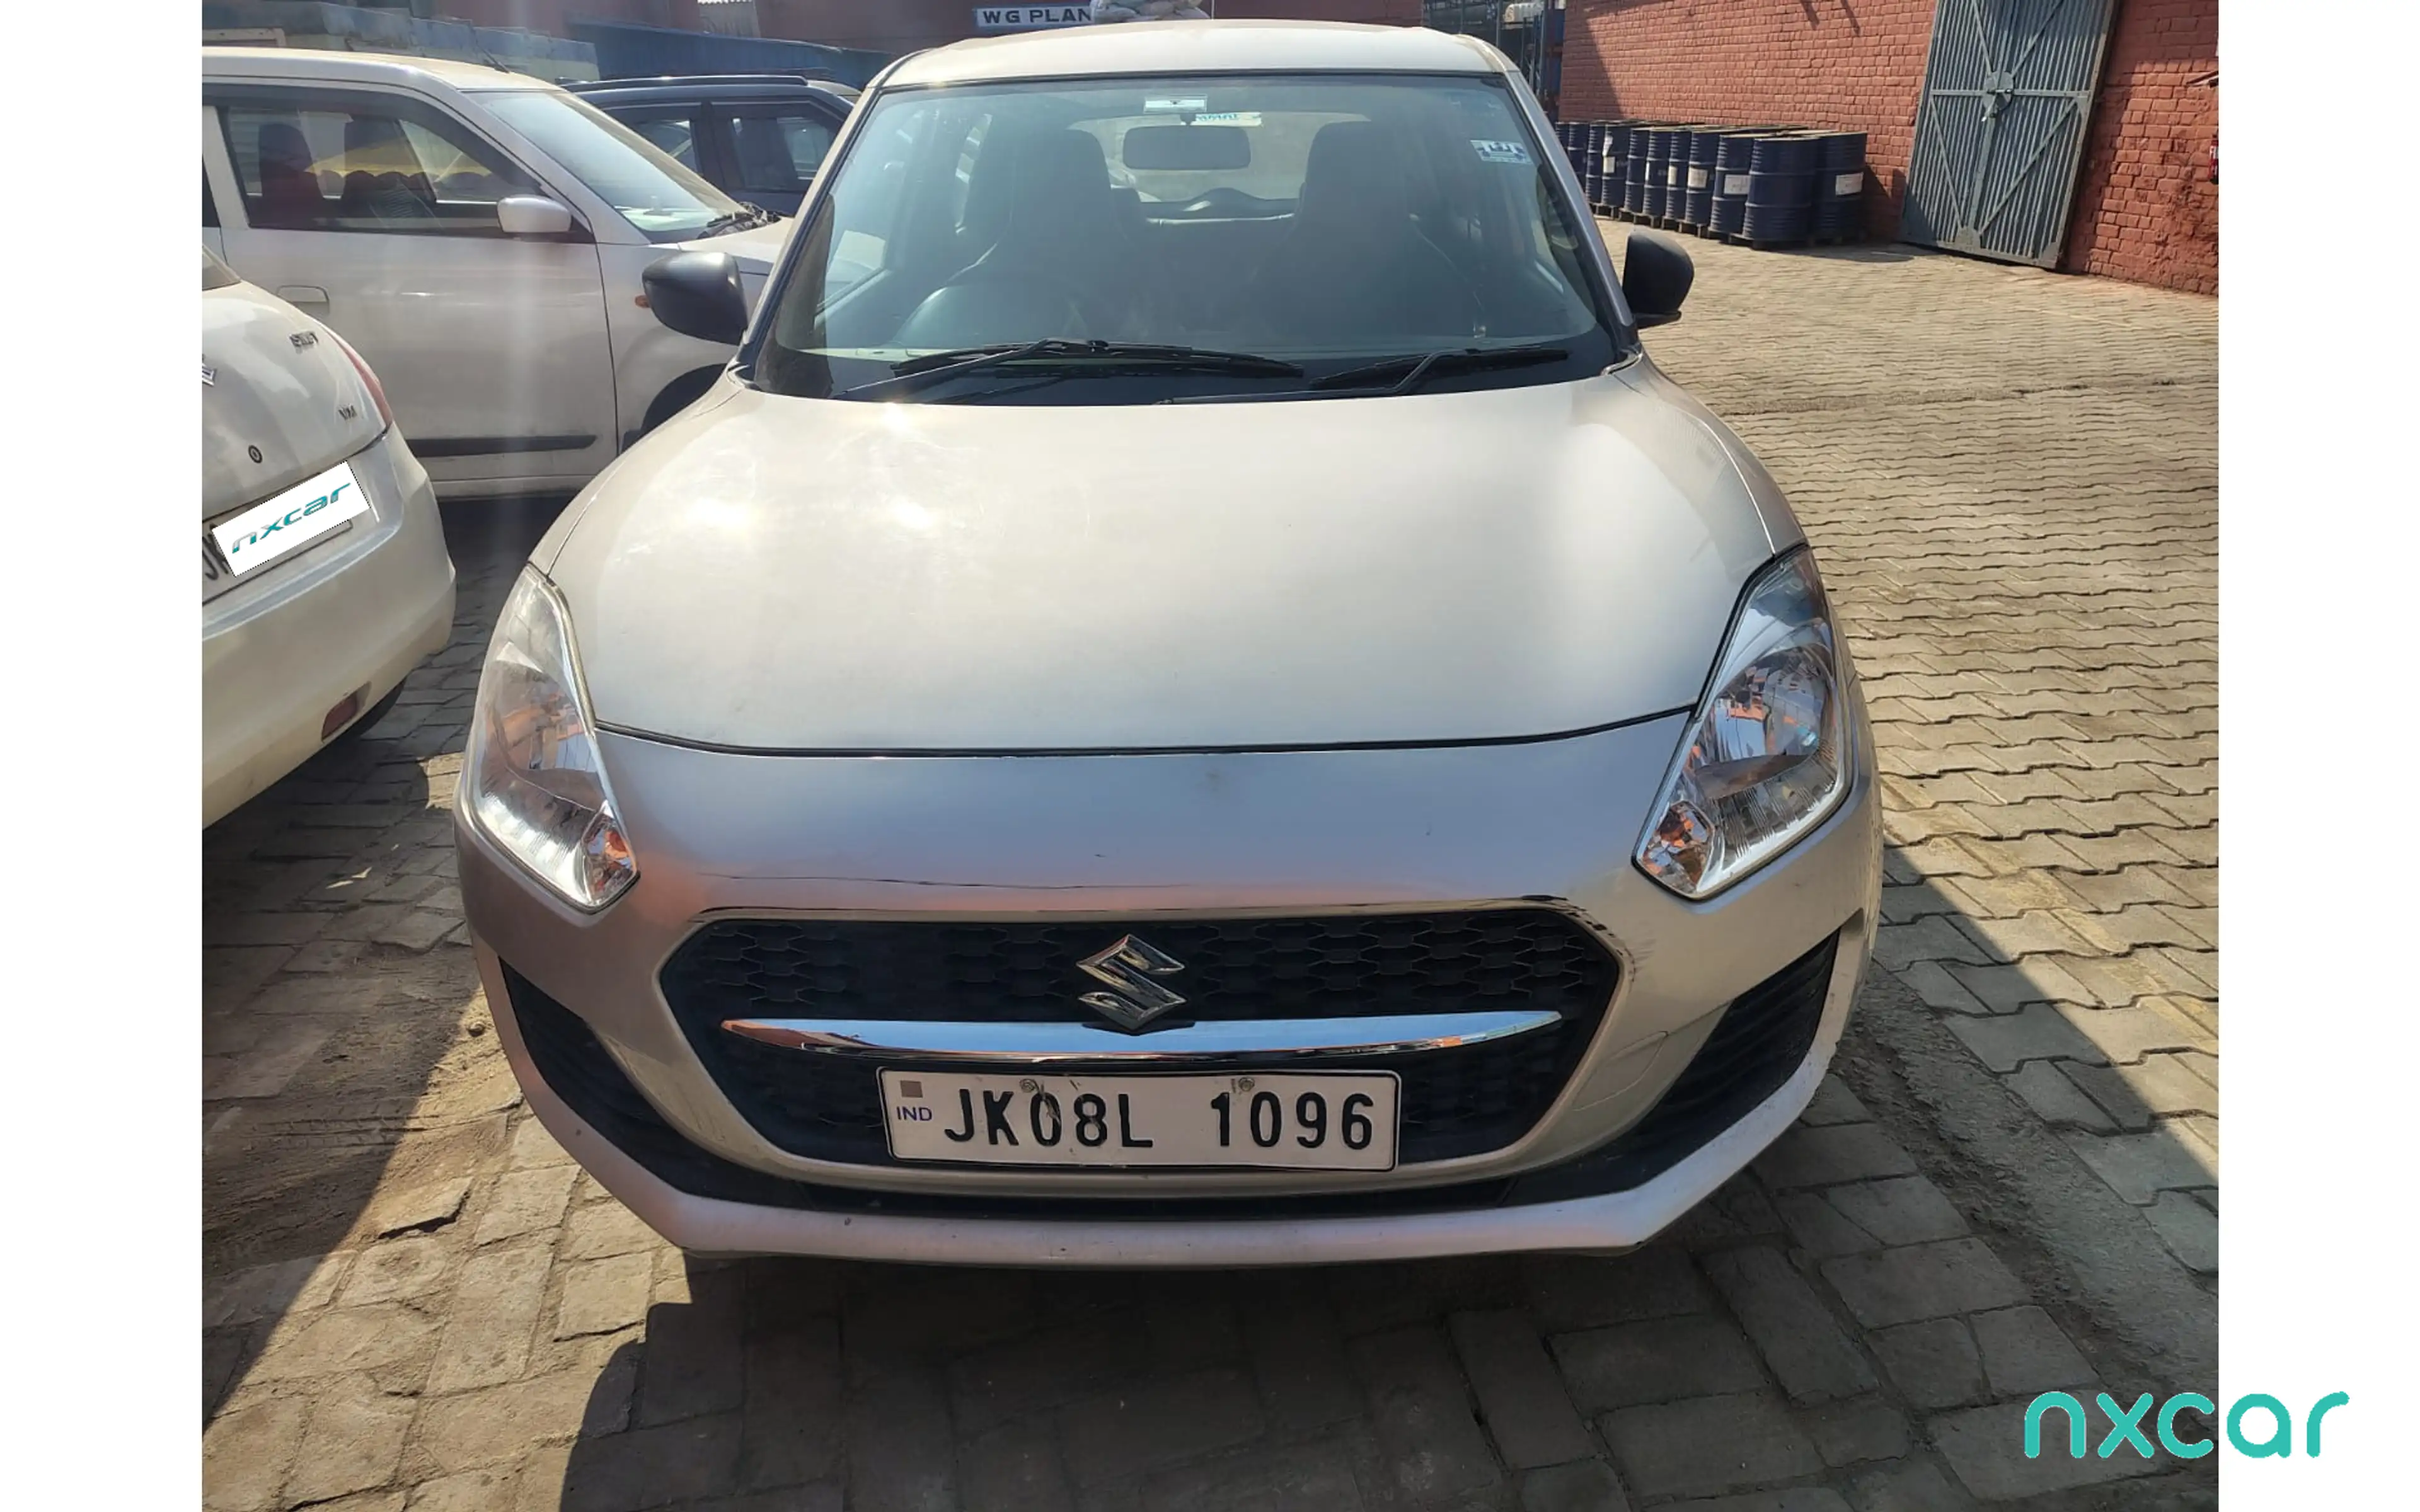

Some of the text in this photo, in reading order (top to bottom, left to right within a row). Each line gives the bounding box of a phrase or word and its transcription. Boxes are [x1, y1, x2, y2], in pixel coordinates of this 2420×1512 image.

[982, 10, 1021, 23] WG
[896, 1106, 933, 1121] IND
[944, 1089, 1374, 1150] JK08L 1096
